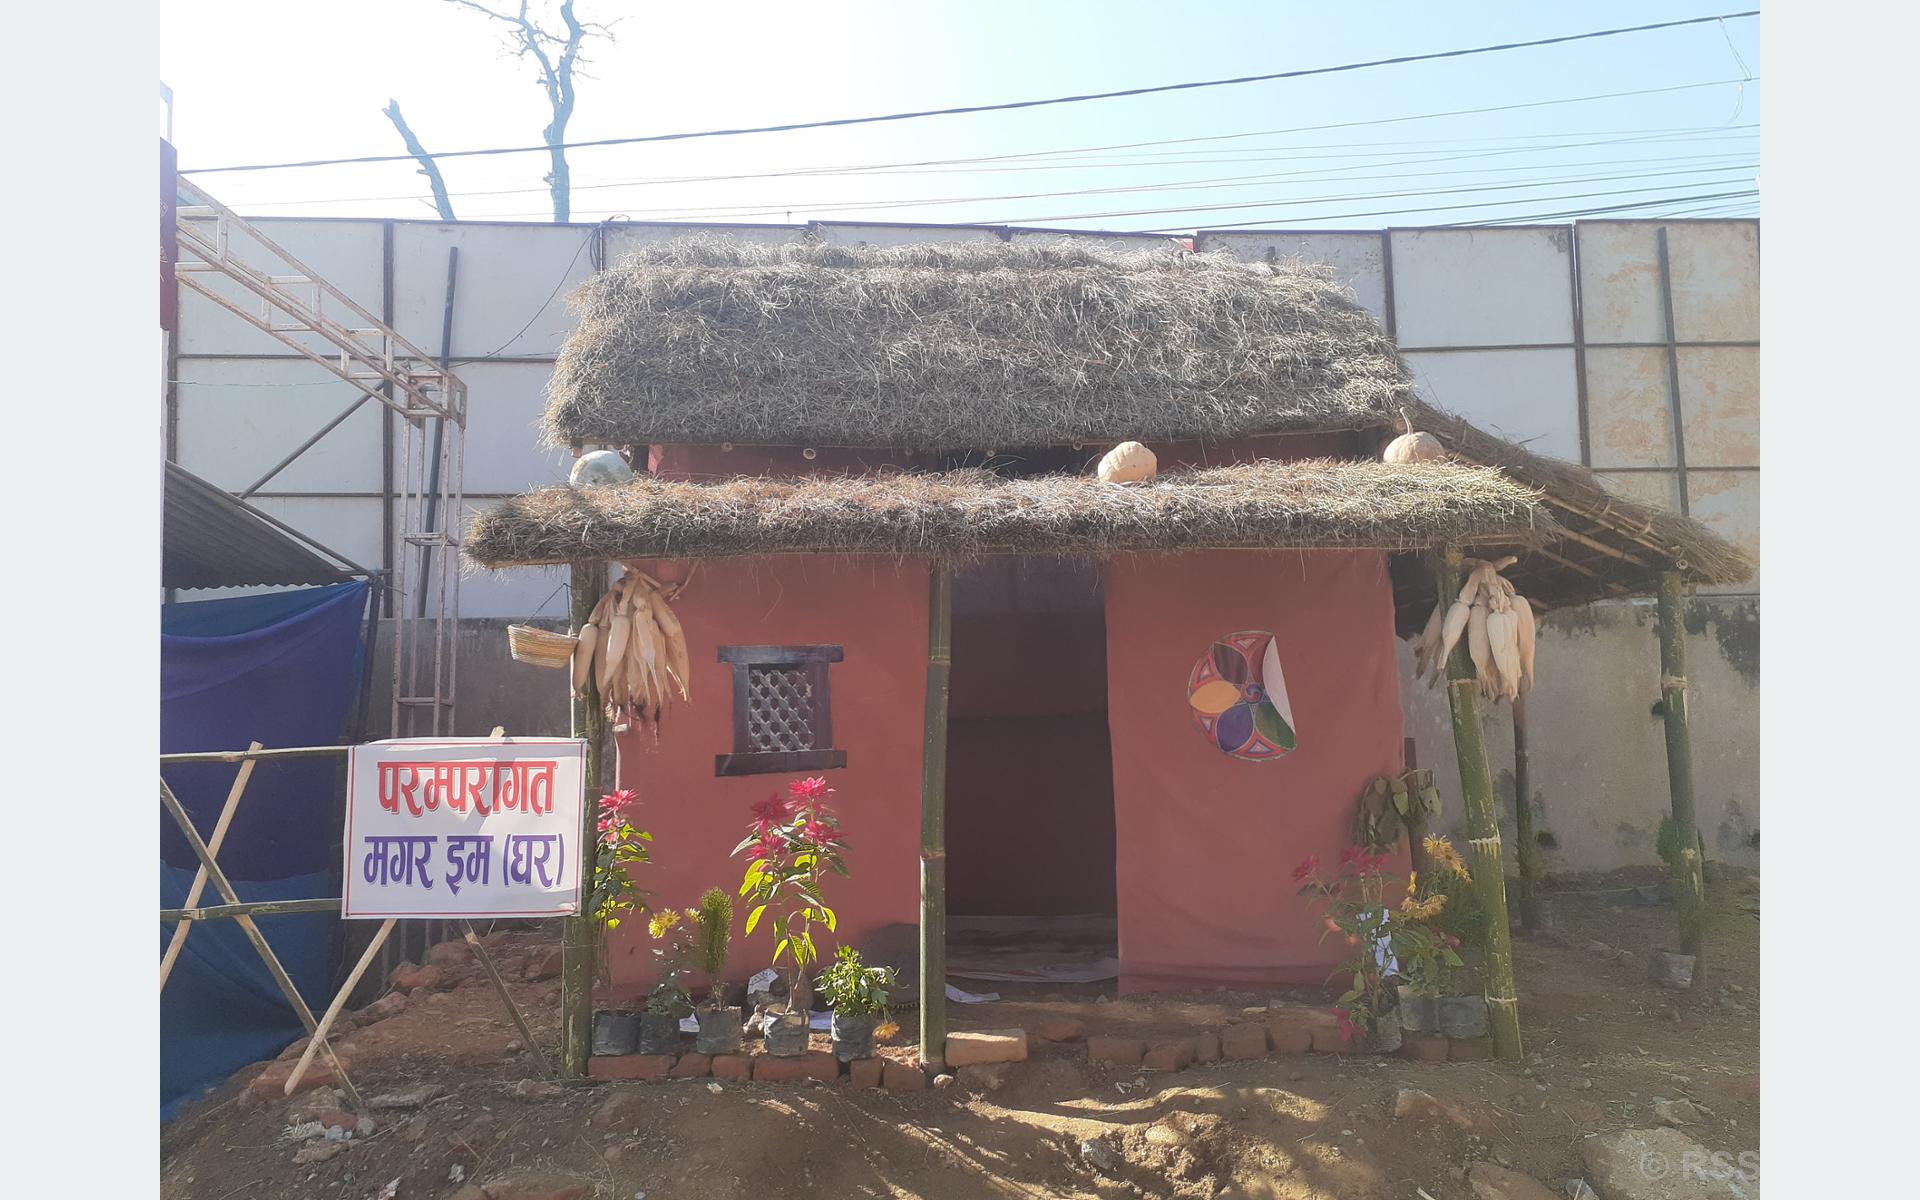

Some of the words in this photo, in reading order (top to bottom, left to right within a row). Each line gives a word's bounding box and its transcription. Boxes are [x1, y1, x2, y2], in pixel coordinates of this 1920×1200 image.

[377, 761, 559, 817] परम्परागत
[363, 835, 438, 889] मगर
[445, 835, 495, 896] इम
[503, 833, 565, 888] (घर)
